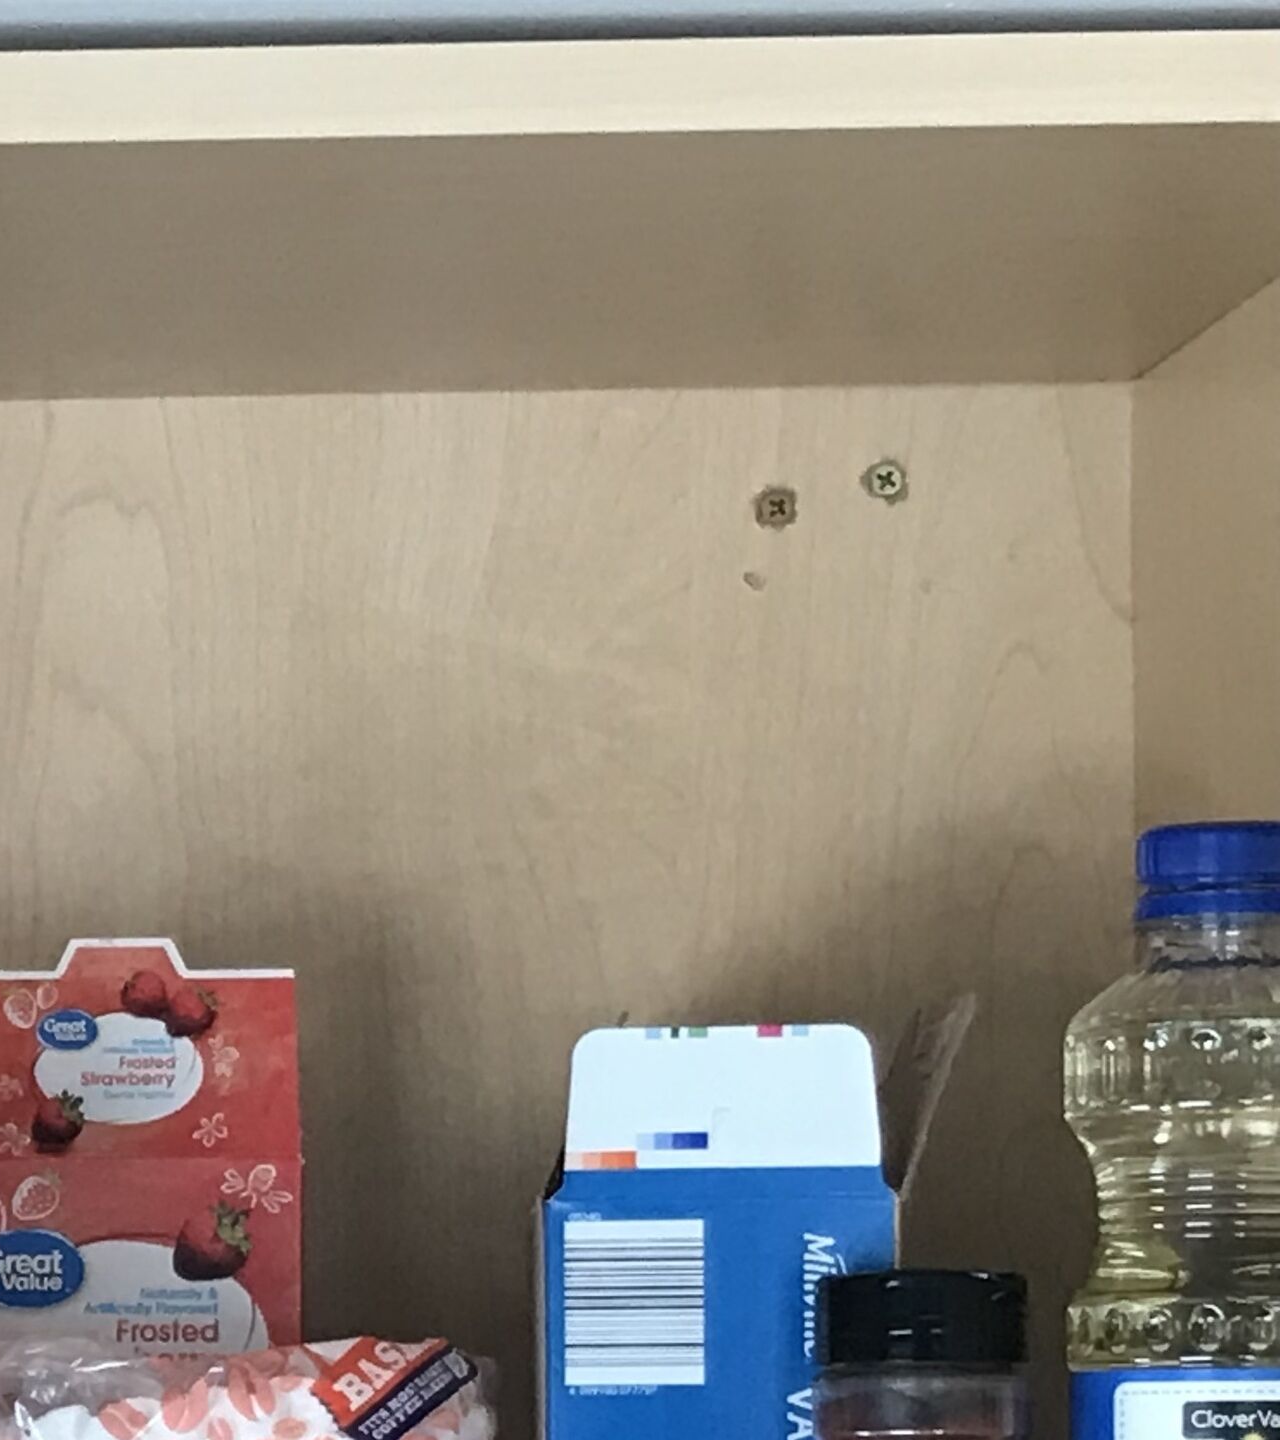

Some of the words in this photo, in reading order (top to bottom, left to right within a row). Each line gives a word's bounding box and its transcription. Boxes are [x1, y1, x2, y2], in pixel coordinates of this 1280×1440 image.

[44, 1019, 87, 1033] Great
[119, 1056, 176, 1069] Frosted
[81, 1071, 175, 1088] Strawberry
[1, 1273, 63, 1292] Value
[116, 1319, 220, 1343] Frosted
